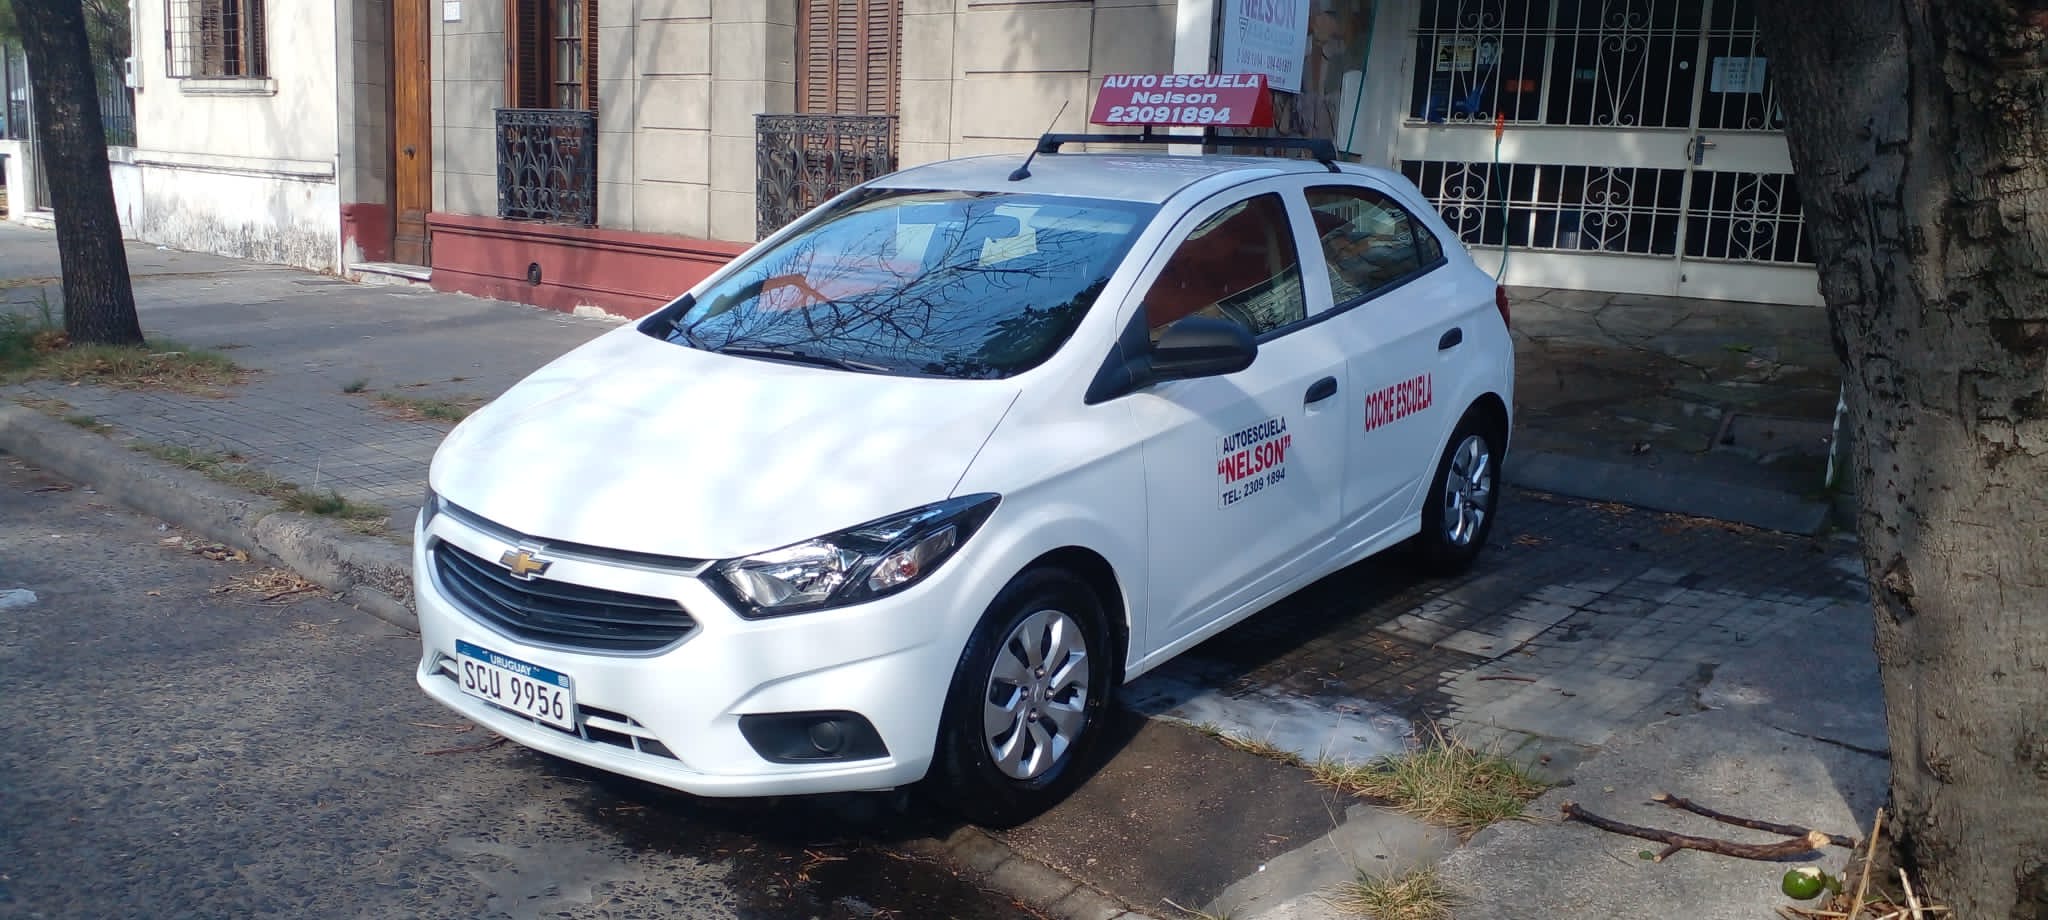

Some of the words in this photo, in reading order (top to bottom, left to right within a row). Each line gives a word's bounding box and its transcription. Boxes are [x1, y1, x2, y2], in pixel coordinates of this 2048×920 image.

[1104, 75, 1157, 88] AUTO
[1160, 75, 1259, 88] ESCUELA
[1131, 91, 1217, 104] Nelson
[1107, 106, 1230, 123] 23091894
[1365, 385, 1394, 432] COCHE
[1396, 371, 1432, 419] ESCUELA
[1223, 416, 1286, 455] AUTOESCUELA
[1217, 434, 1291, 484] “NELSON”
[1222, 488, 1241, 506] TEL:
[1244, 477, 1264, 497] 2309
[1266, 467, 1286, 487] 1894
[489, 654, 532, 676] URUGUAY
[464, 660, 501, 699] SCU
[511, 677, 563, 720] 9956
